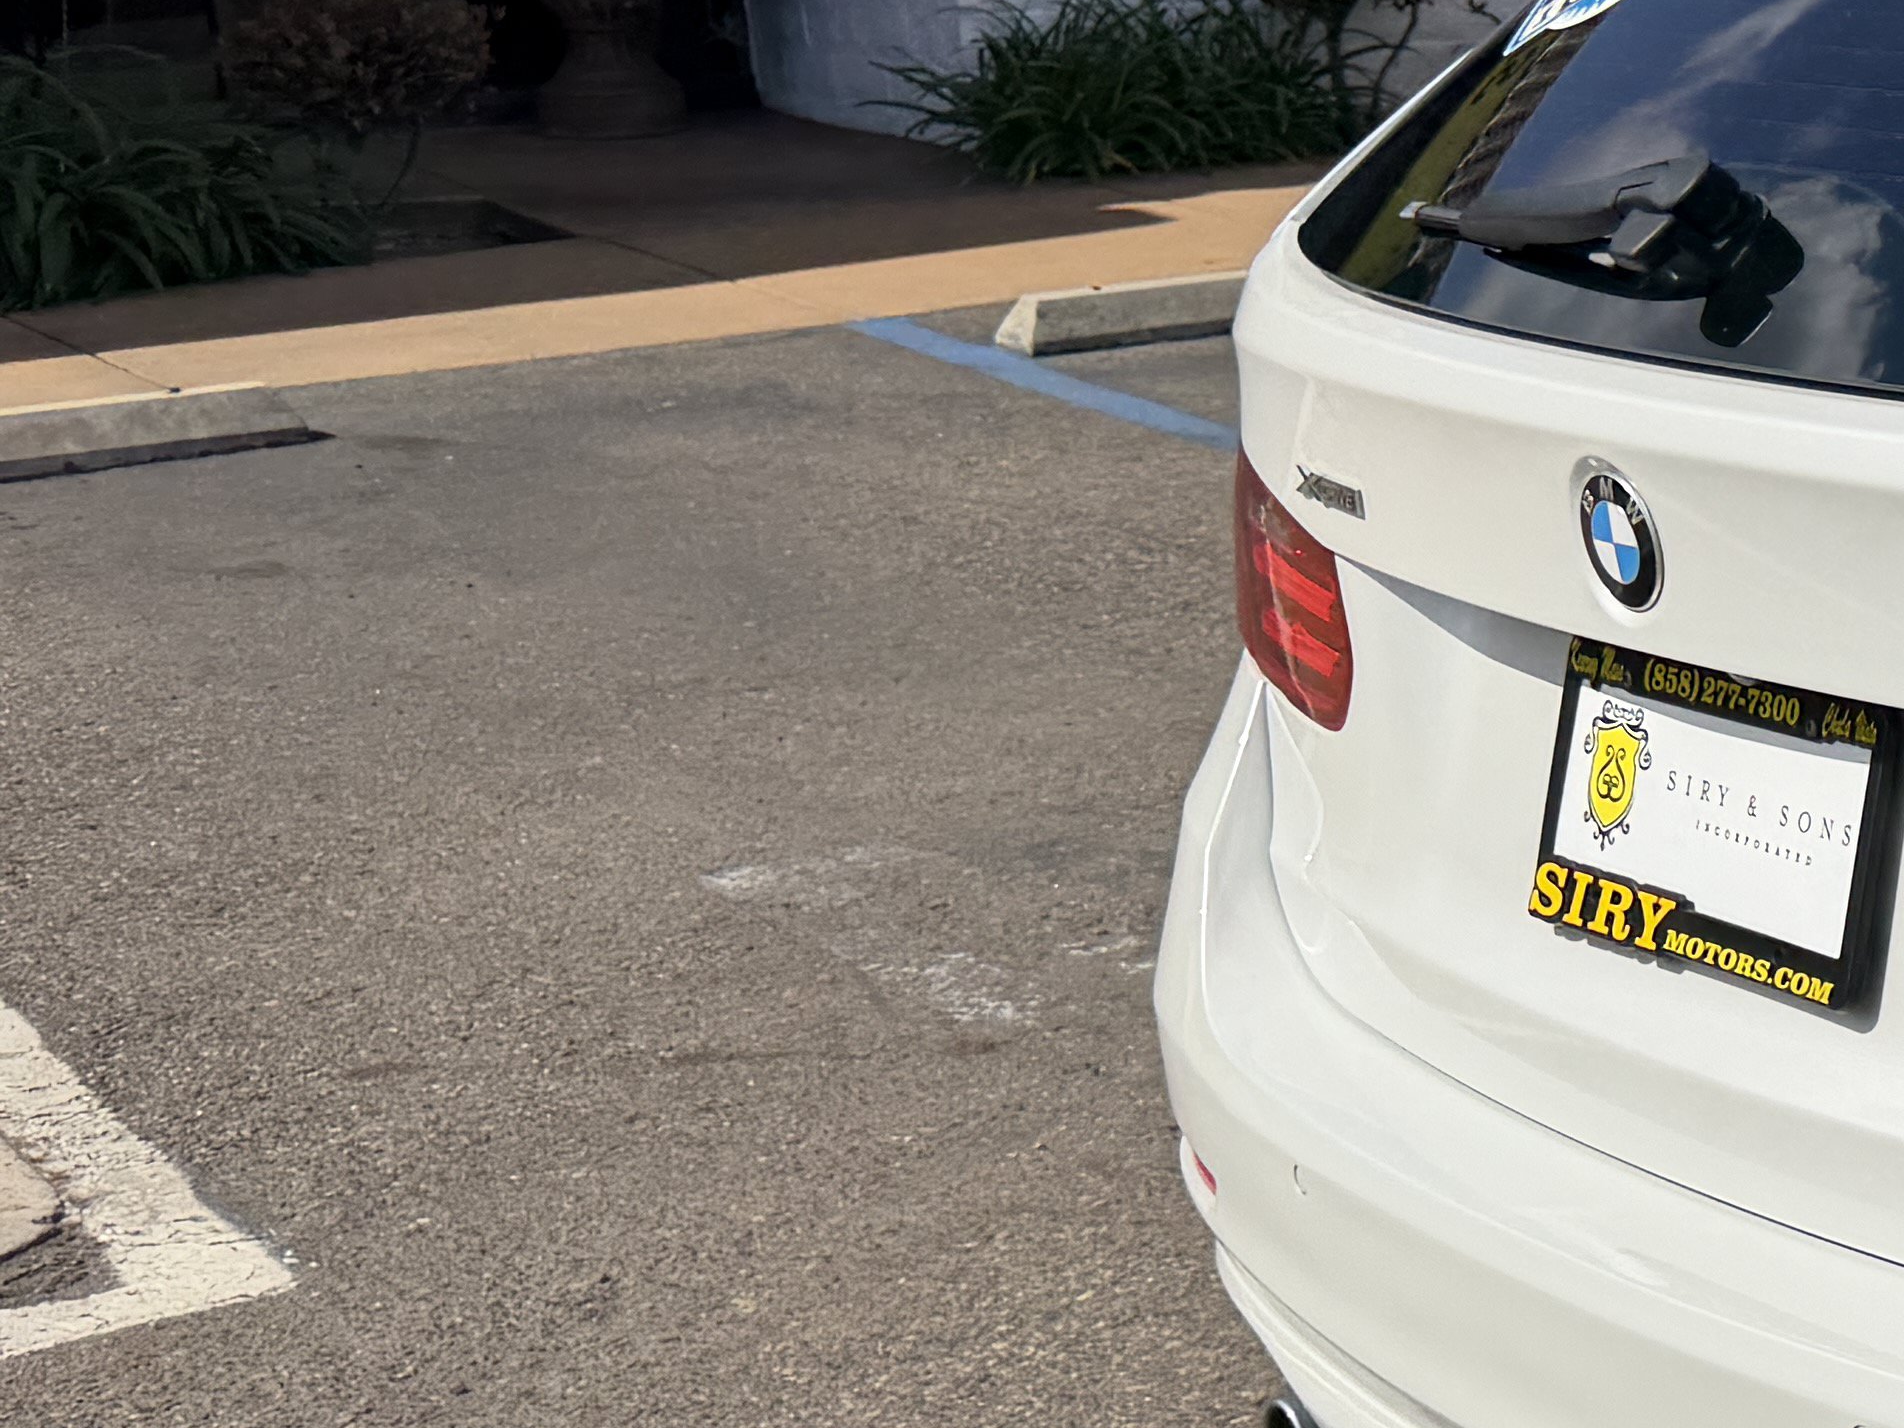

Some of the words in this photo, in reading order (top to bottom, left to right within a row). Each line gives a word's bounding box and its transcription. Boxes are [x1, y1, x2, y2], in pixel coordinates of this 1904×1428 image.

[1667, 770, 1730, 808] SIRY
[1747, 794, 1758, 818] &
[1778, 804, 1852, 847] SONS
[1695, 819, 1813, 866] INCORPORATED
[1529, 862, 1677, 952] SIRY
[1663, 929, 1835, 1005] MOTORS.COM
